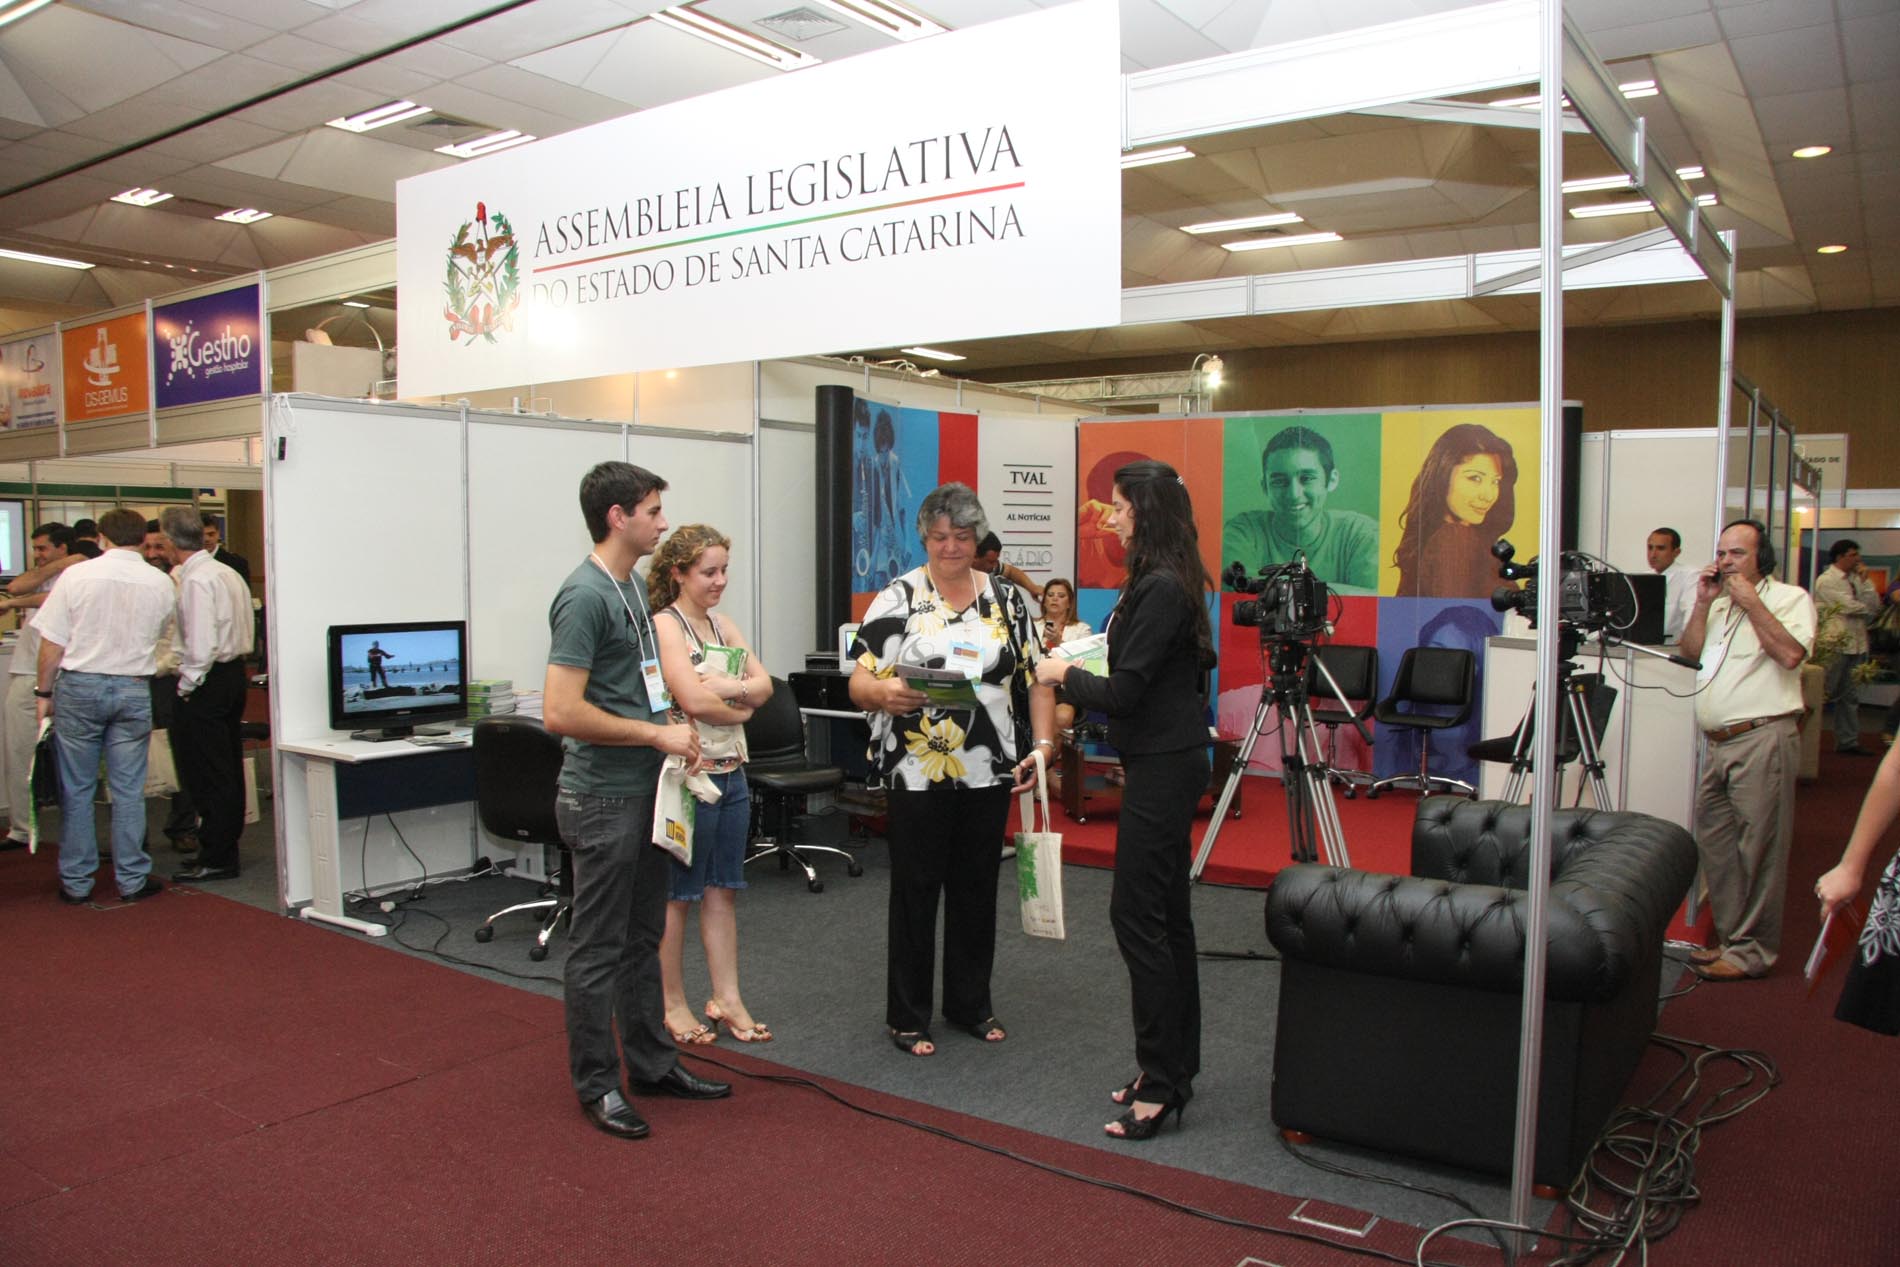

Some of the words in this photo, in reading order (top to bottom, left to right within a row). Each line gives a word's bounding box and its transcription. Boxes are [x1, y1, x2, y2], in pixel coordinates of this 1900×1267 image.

[534, 182, 732, 258] ASSEMBLEIA
[746, 124, 1023, 216] LEGISLATIVA
[533, 279, 568, 308] DO
[577, 260, 674, 304] ESTADO
[685, 251, 721, 286] DE
[731, 234, 831, 280] SANTA
[840, 203, 1027, 262] CATARINA
[188, 324, 251, 367] Gestho
[1010, 471, 1047, 485] TVAL
[1006, 513, 1016, 521] AL
[1002, 549, 1053, 565] RÁDIO
